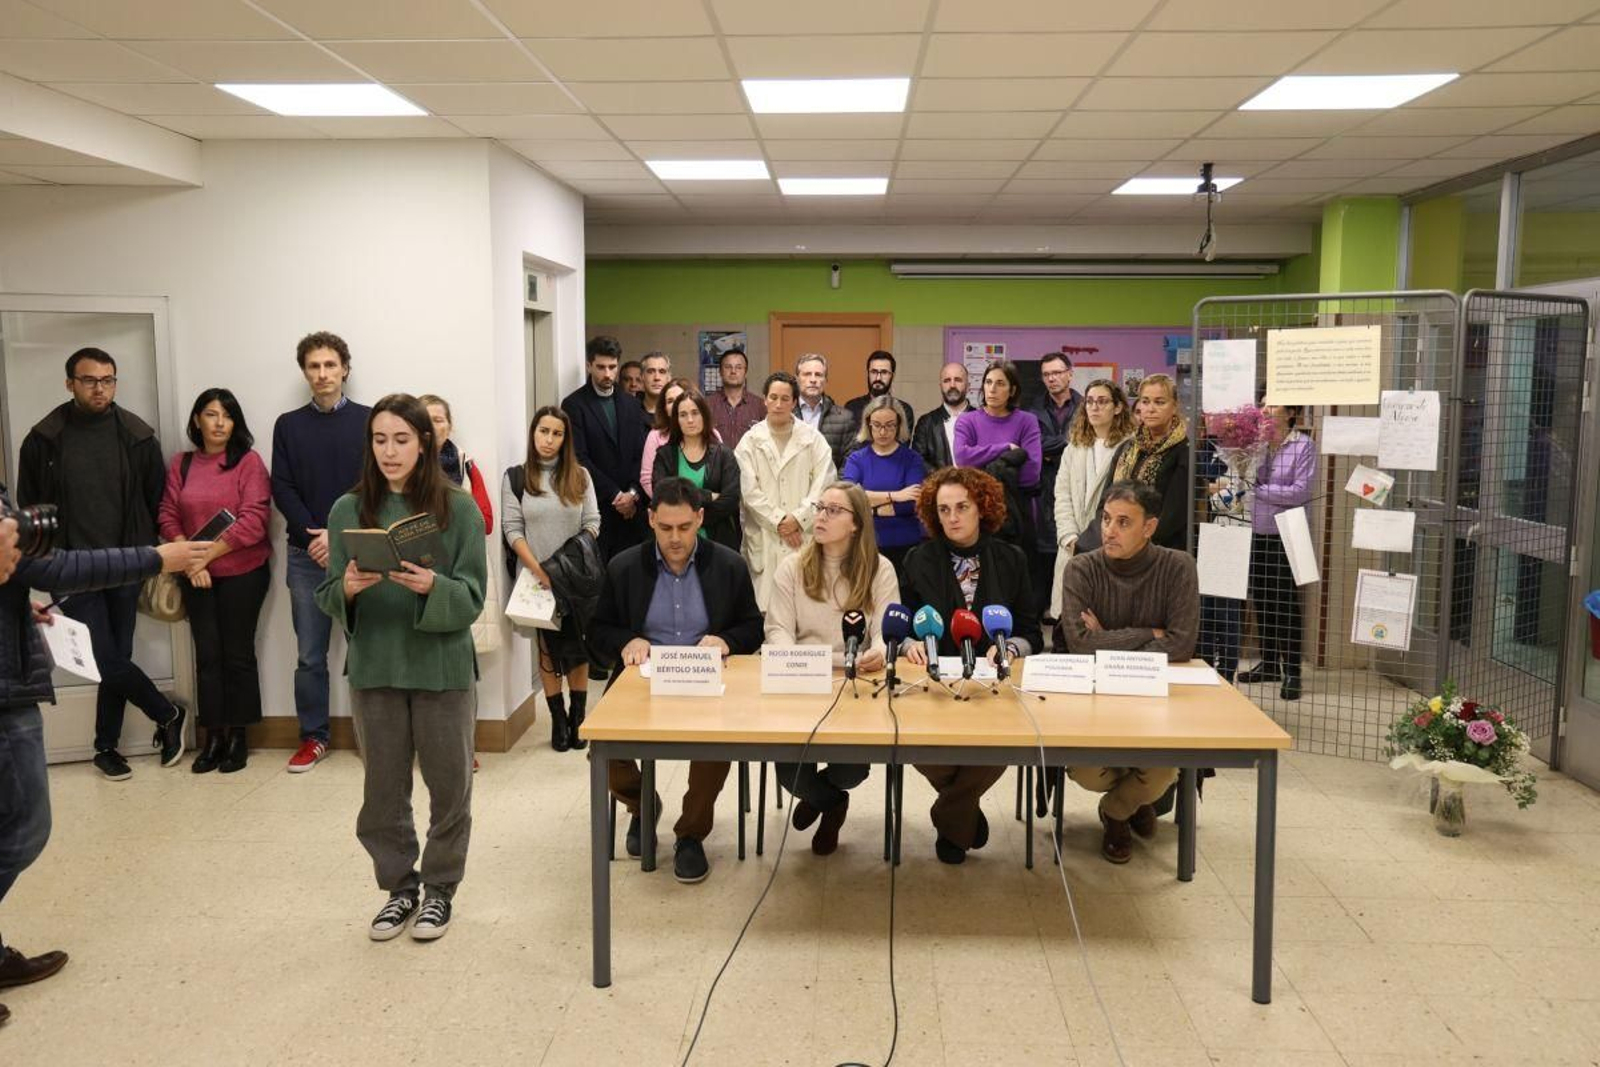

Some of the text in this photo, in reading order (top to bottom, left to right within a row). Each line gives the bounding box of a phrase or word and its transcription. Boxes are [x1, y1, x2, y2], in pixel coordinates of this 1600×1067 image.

[661, 650, 712, 660] JOSÉ MANUEL
[656, 664, 691, 673] BÉRTOLO
